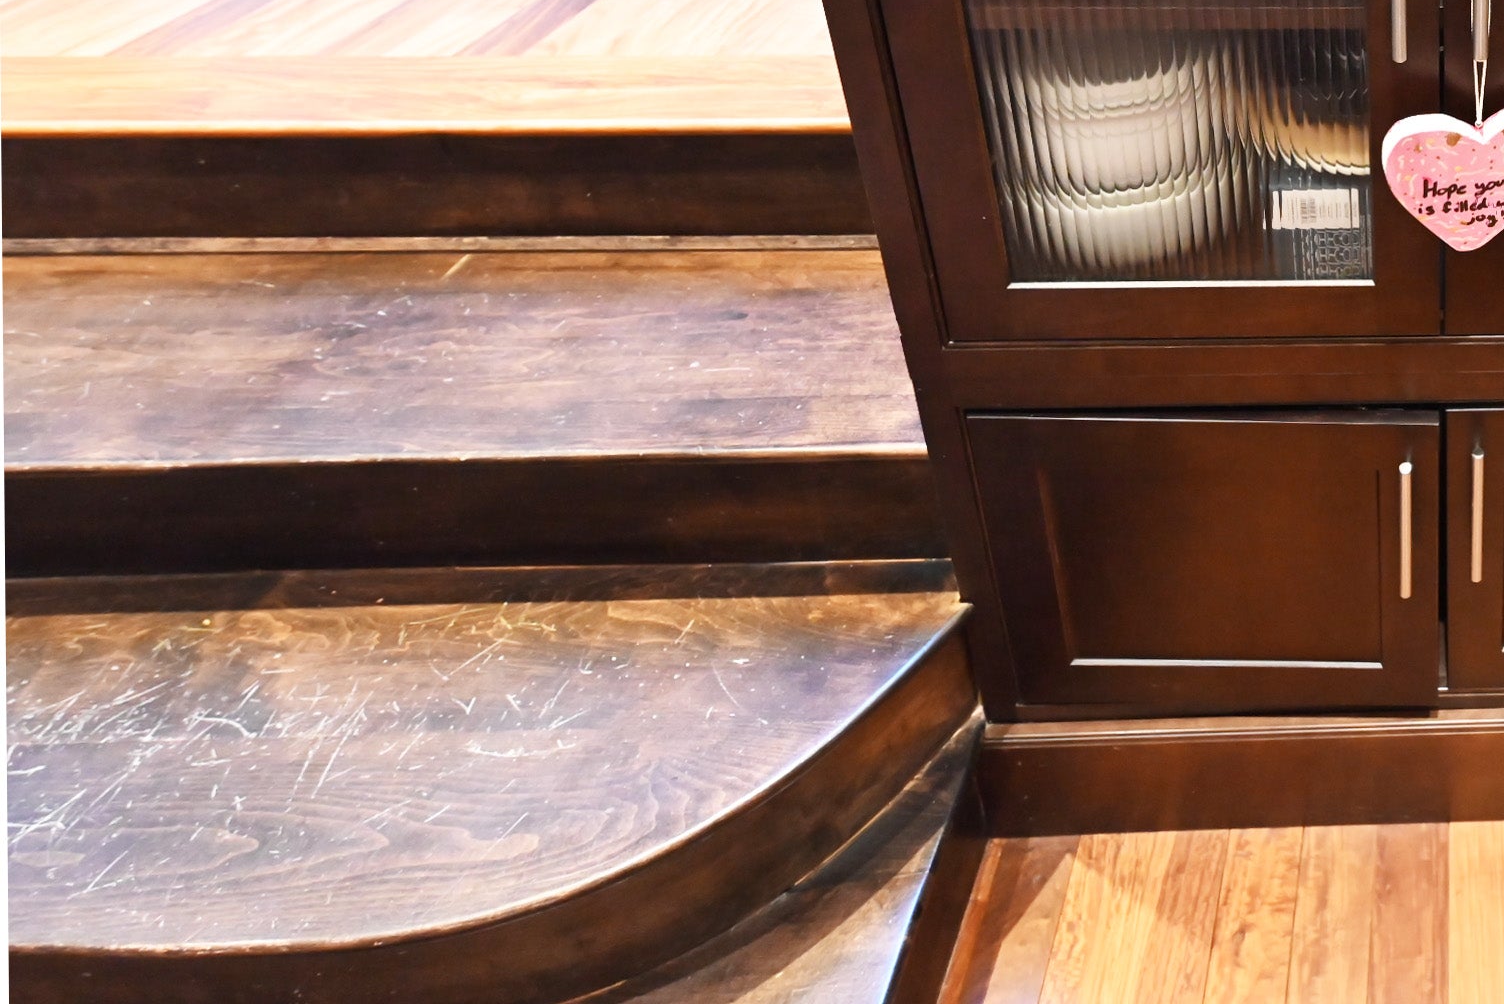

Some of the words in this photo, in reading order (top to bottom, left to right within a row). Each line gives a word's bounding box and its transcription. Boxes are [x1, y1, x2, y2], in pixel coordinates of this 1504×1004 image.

[1423, 178, 1467, 199] Hope
[1418, 203, 1435, 215] is
[1442, 198, 1488, 213] filled
